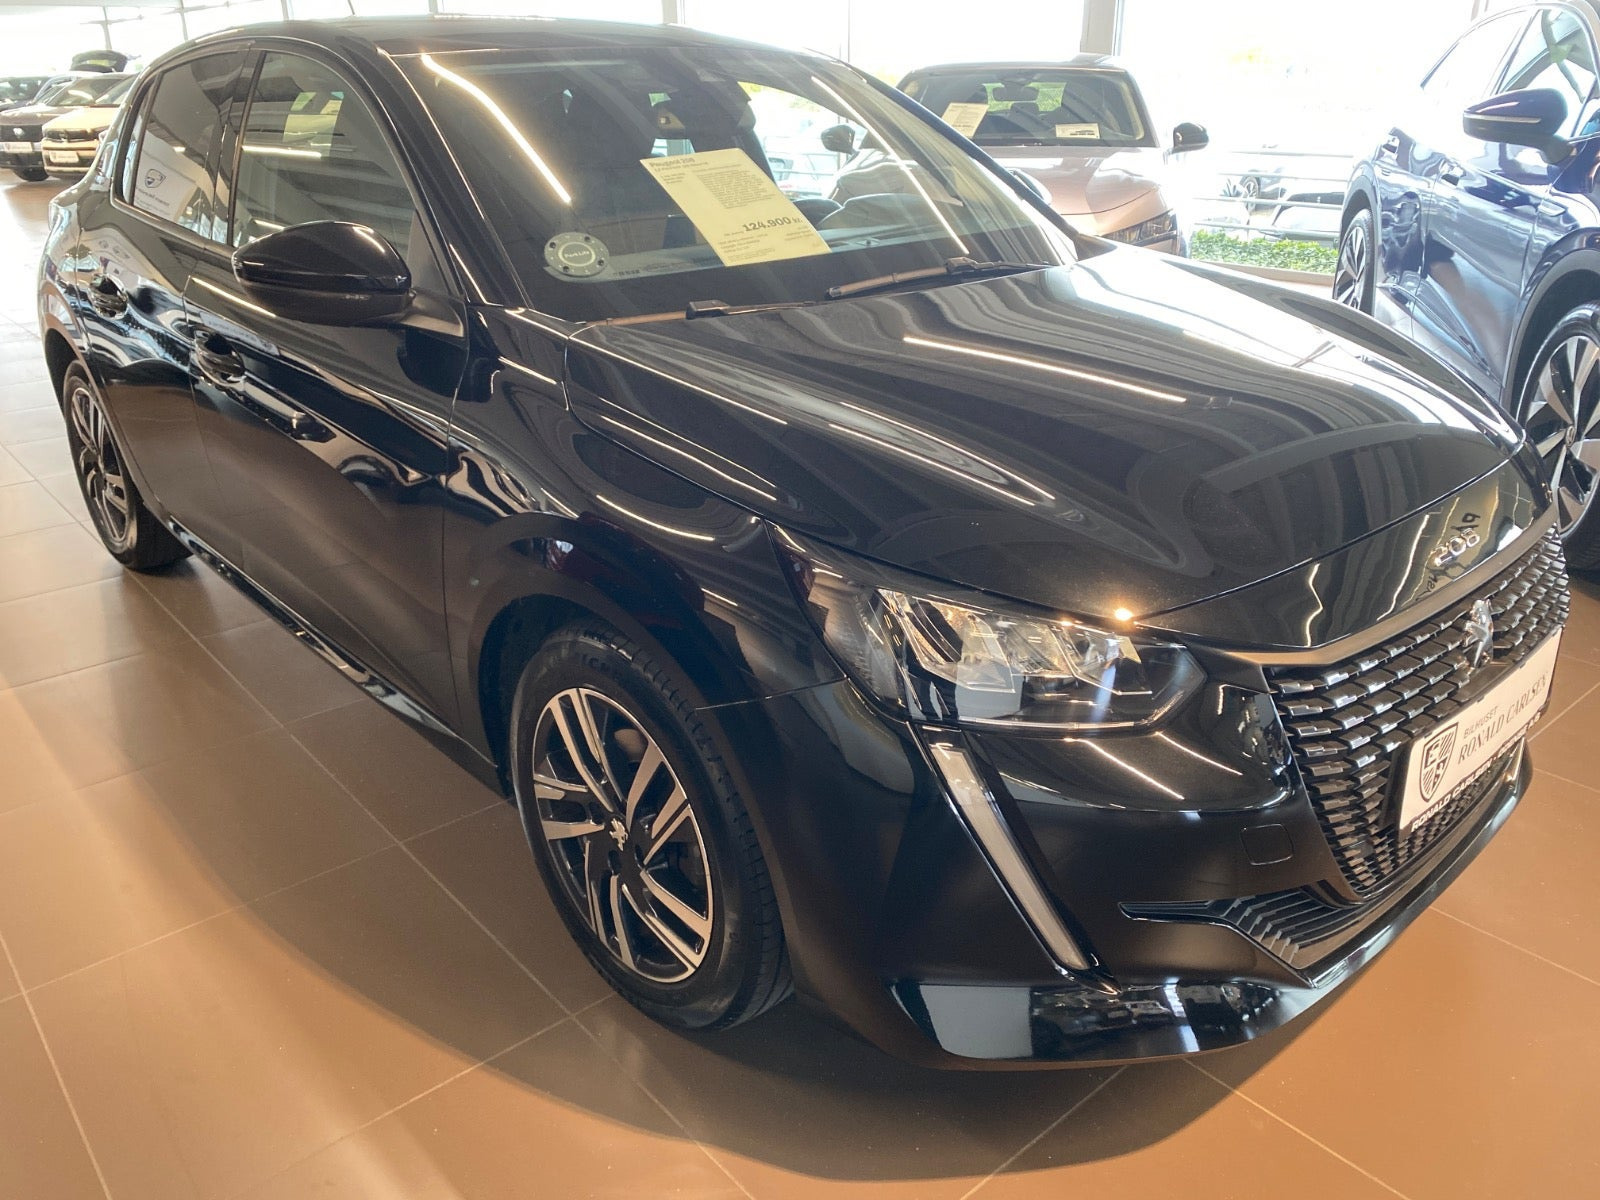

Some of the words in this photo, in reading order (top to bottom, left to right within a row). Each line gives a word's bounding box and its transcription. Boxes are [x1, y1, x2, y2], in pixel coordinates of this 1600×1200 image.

[742, 216, 792, 232] 124.900
[1434, 527, 1481, 567] 208
[1457, 713, 1505, 765] RONALD
[1505, 674, 1546, 724] CARLSEN
[1463, 704, 1499, 739] BILHUSET
[1410, 792, 1453, 833] RONALD
